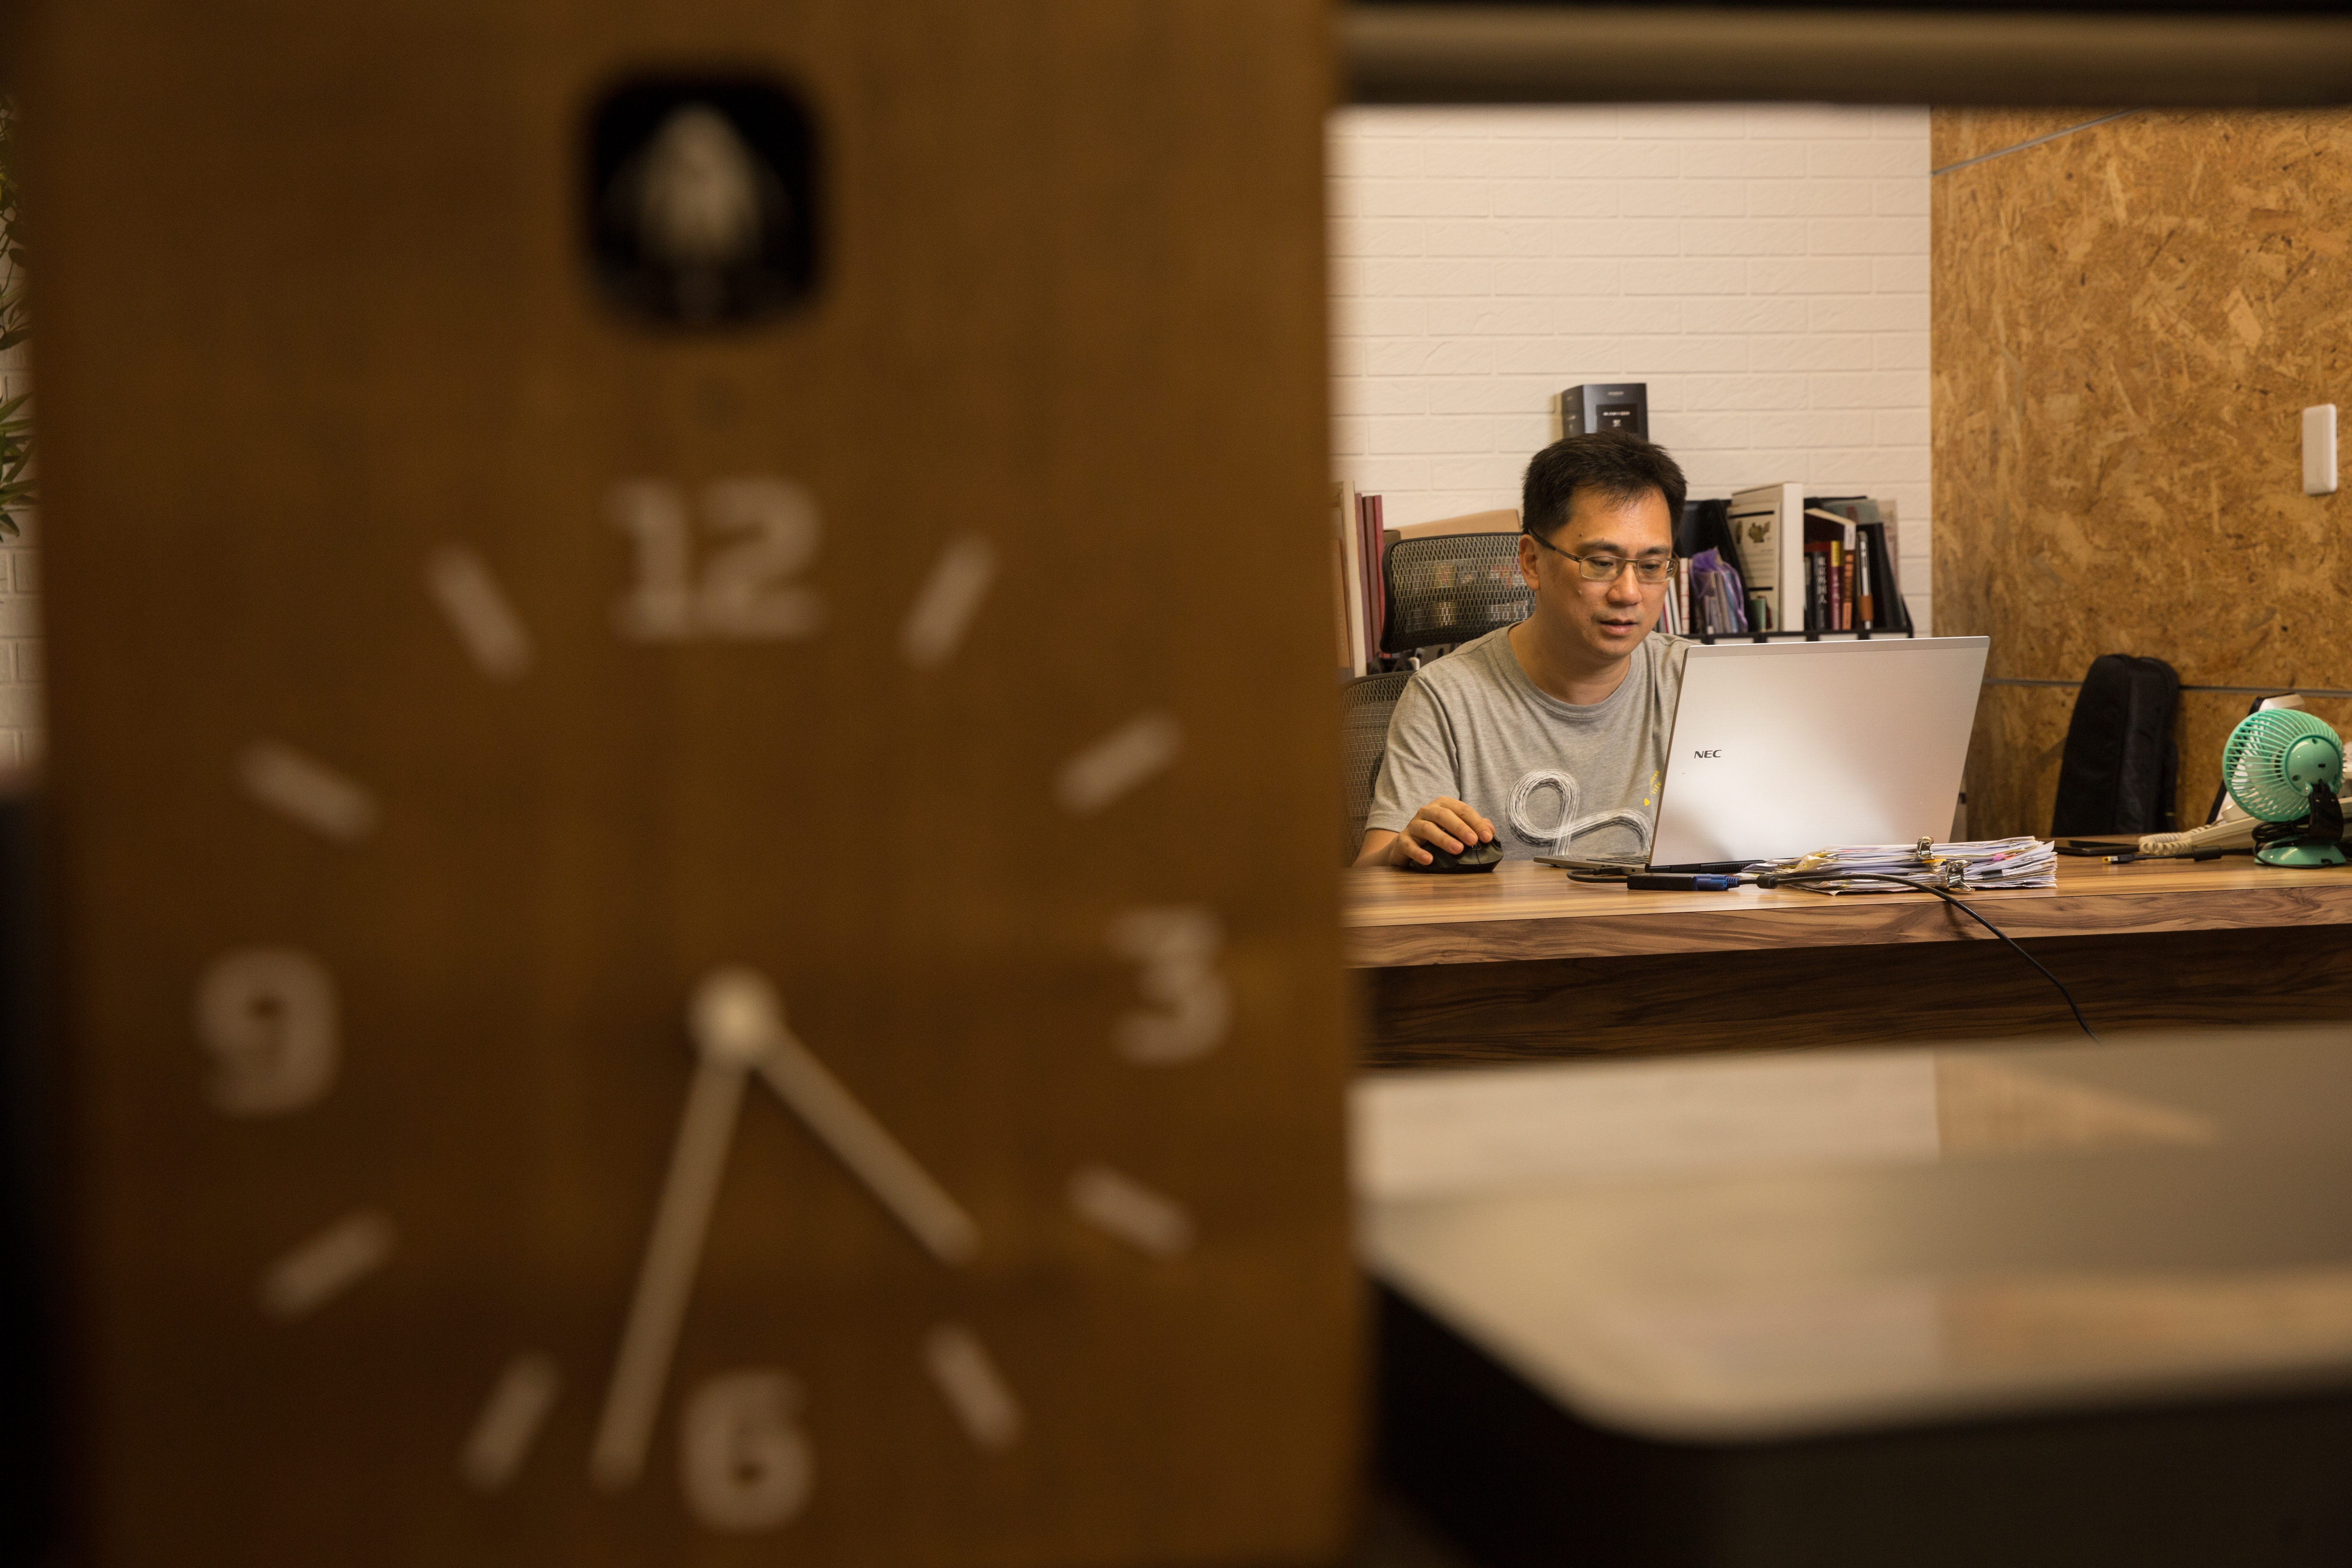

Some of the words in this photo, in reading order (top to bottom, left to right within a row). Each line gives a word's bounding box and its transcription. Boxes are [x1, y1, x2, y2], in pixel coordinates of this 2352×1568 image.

[610, 478, 822, 638] 12
[1652, 782, 1662, 795] life
[1694, 750, 1722, 758] NEC
[198, 949, 338, 1116] 9
[1111, 907, 1228, 1064] 3
[683, 1370, 813, 1531] 6
